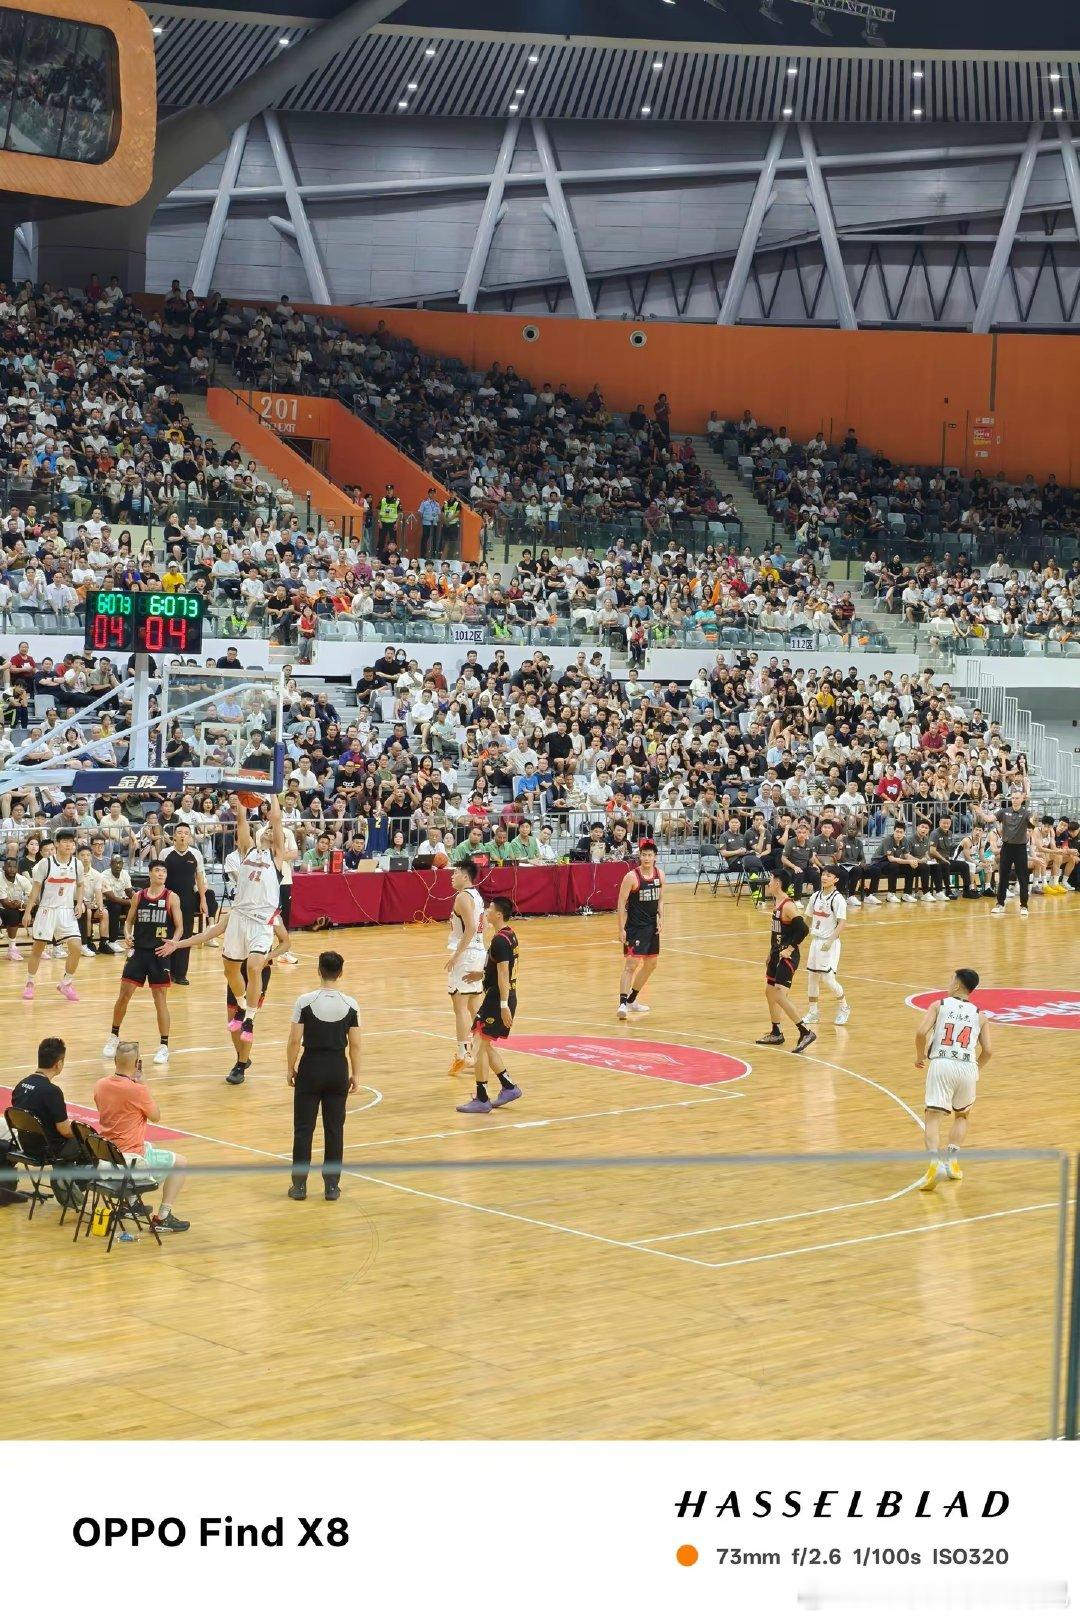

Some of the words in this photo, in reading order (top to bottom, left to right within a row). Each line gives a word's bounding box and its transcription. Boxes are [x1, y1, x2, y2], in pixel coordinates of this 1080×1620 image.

[261, 396, 298, 420] 201
[95, 615, 123, 648] 04
[145, 616, 186, 650] 04
[455, 630, 482, 642] 1012区
[791, 639, 813, 650] 112区
[118, 775, 159, 789] 金陵
[940, 1022, 973, 1049] 14
